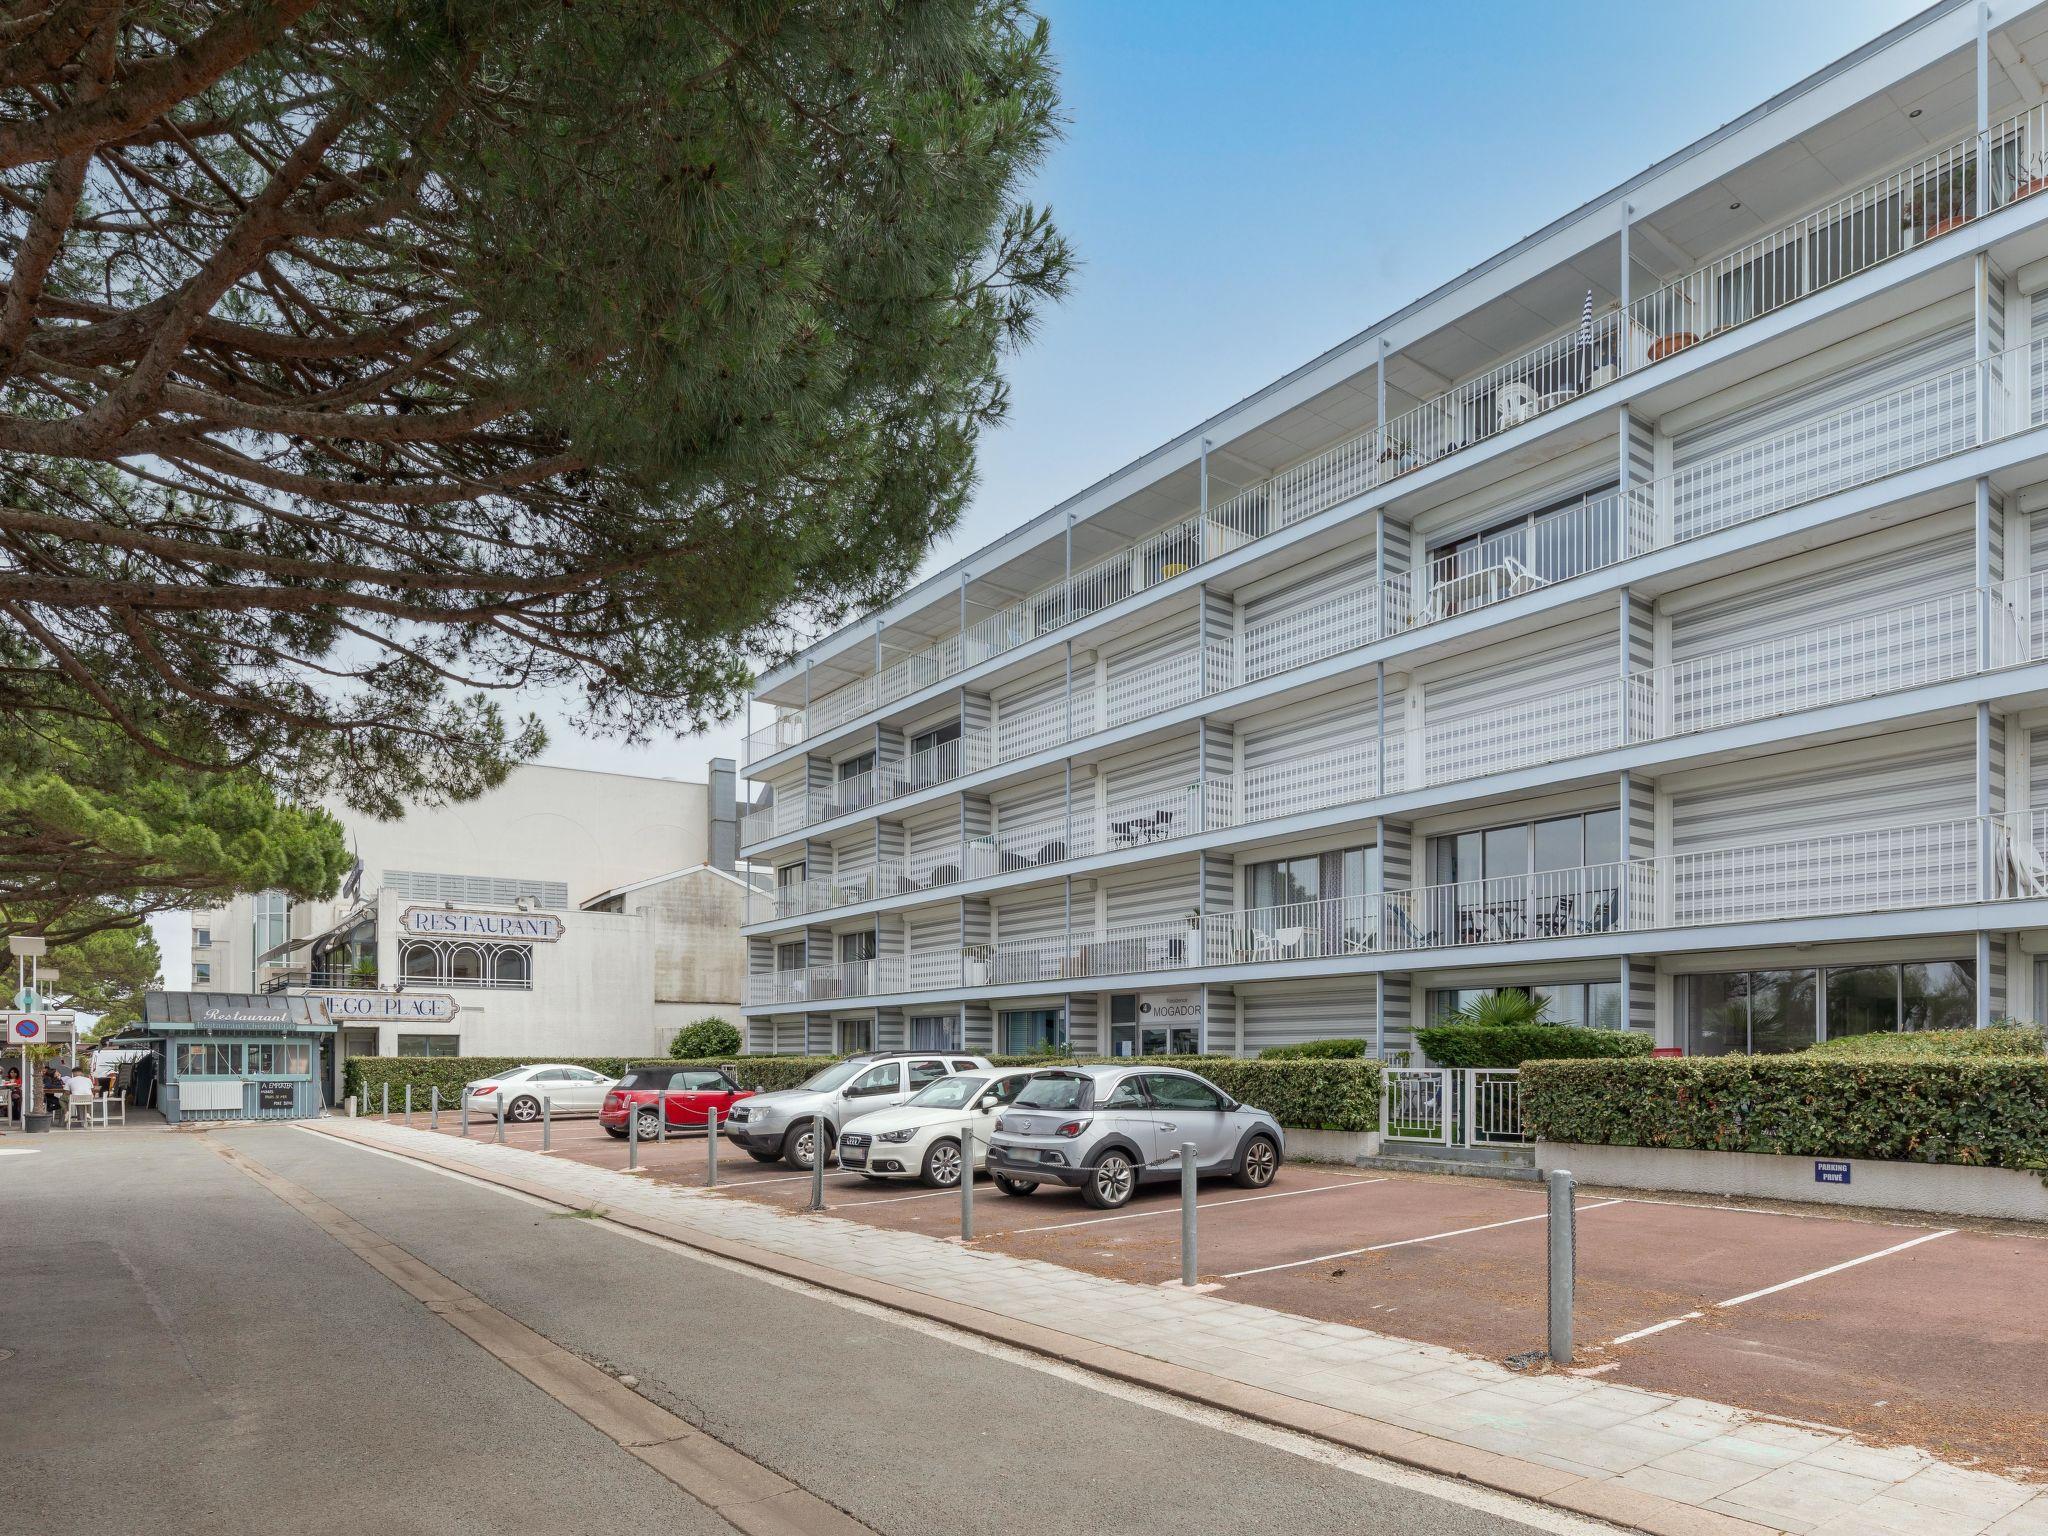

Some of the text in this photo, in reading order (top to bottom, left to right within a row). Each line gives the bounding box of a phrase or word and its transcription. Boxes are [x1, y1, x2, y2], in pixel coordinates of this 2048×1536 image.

[416, 913, 552, 936] RESTAURANT
[326, 997, 445, 1016] IEGO PLAGE
[1153, 1005, 1202, 1017] MOGADOR
[203, 1008, 288, 1022] Restaurant
[1818, 1163, 1847, 1172] PARKING
[1823, 1173, 1843, 1182] PRIVÉ
